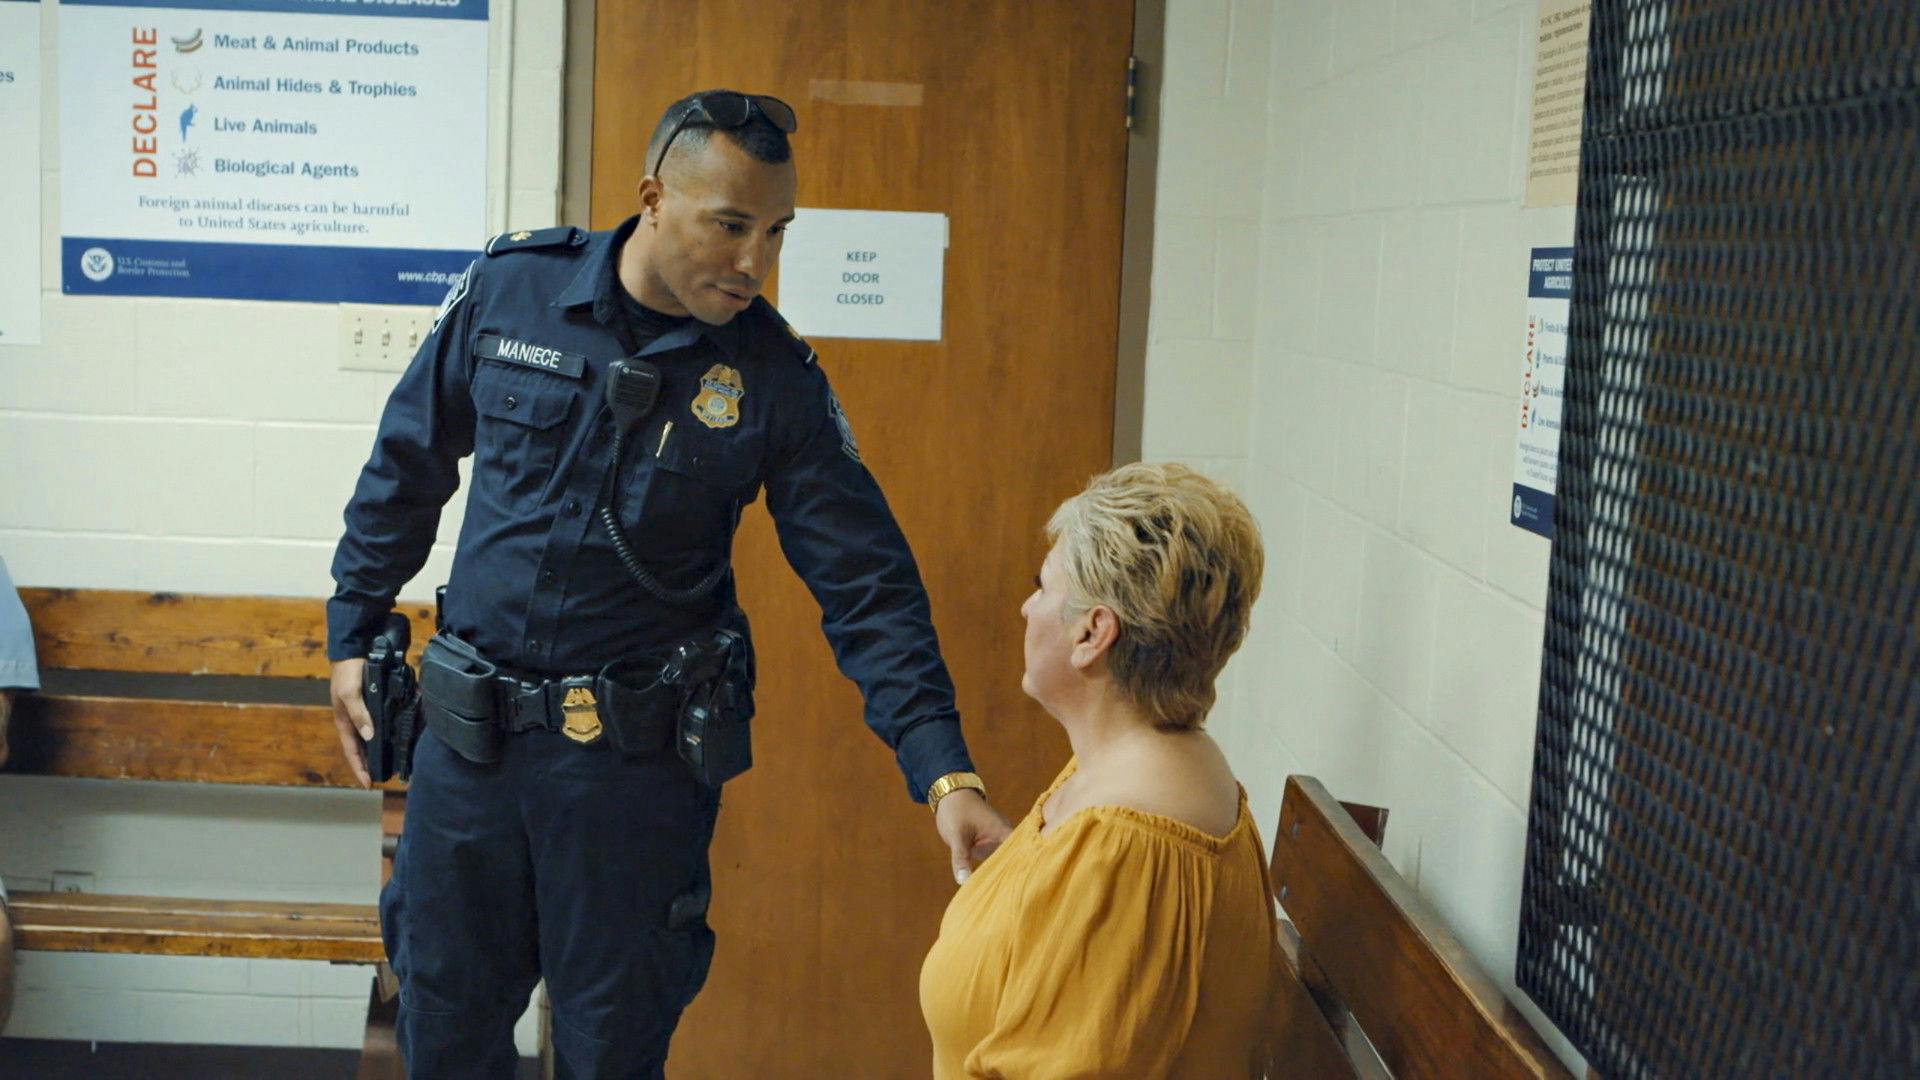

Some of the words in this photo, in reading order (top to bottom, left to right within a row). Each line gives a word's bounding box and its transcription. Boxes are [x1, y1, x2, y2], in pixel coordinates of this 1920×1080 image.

[214, 34, 257, 49] Meat
[263, 35, 276, 49] &
[283, 36, 339, 52] Animal
[346, 38, 420, 56] Products
[214, 75, 270, 91] Animal
[277, 78, 323, 93] Hides
[329, 80, 342, 94] &
[349, 80, 418, 98] Trophies
[132, 26, 157, 177] DECLARE
[214, 117, 246, 132] Live
[252, 119, 318, 135] Animals
[214, 158, 295, 177] Biological
[301, 162, 359, 179] Agents
[139, 195, 191, 212] Foreign
[193, 197, 243, 211] animal
[246, 199, 299, 213] diseases
[304, 203, 328, 214] can
[332, 201, 348, 214] be
[353, 202, 410, 217] harmful
[178, 217, 193, 227] to
[198, 216, 244, 229] United
[248, 218, 286, 231] States
[290, 220, 369, 235] agriculture.
[846, 251, 877, 262] KEEP
[1532, 259, 1555, 272] PROTECT
[842, 272, 880, 283] DOOR
[836, 293, 884, 305] CLOSED
[497, 339, 562, 369] MANIECE
